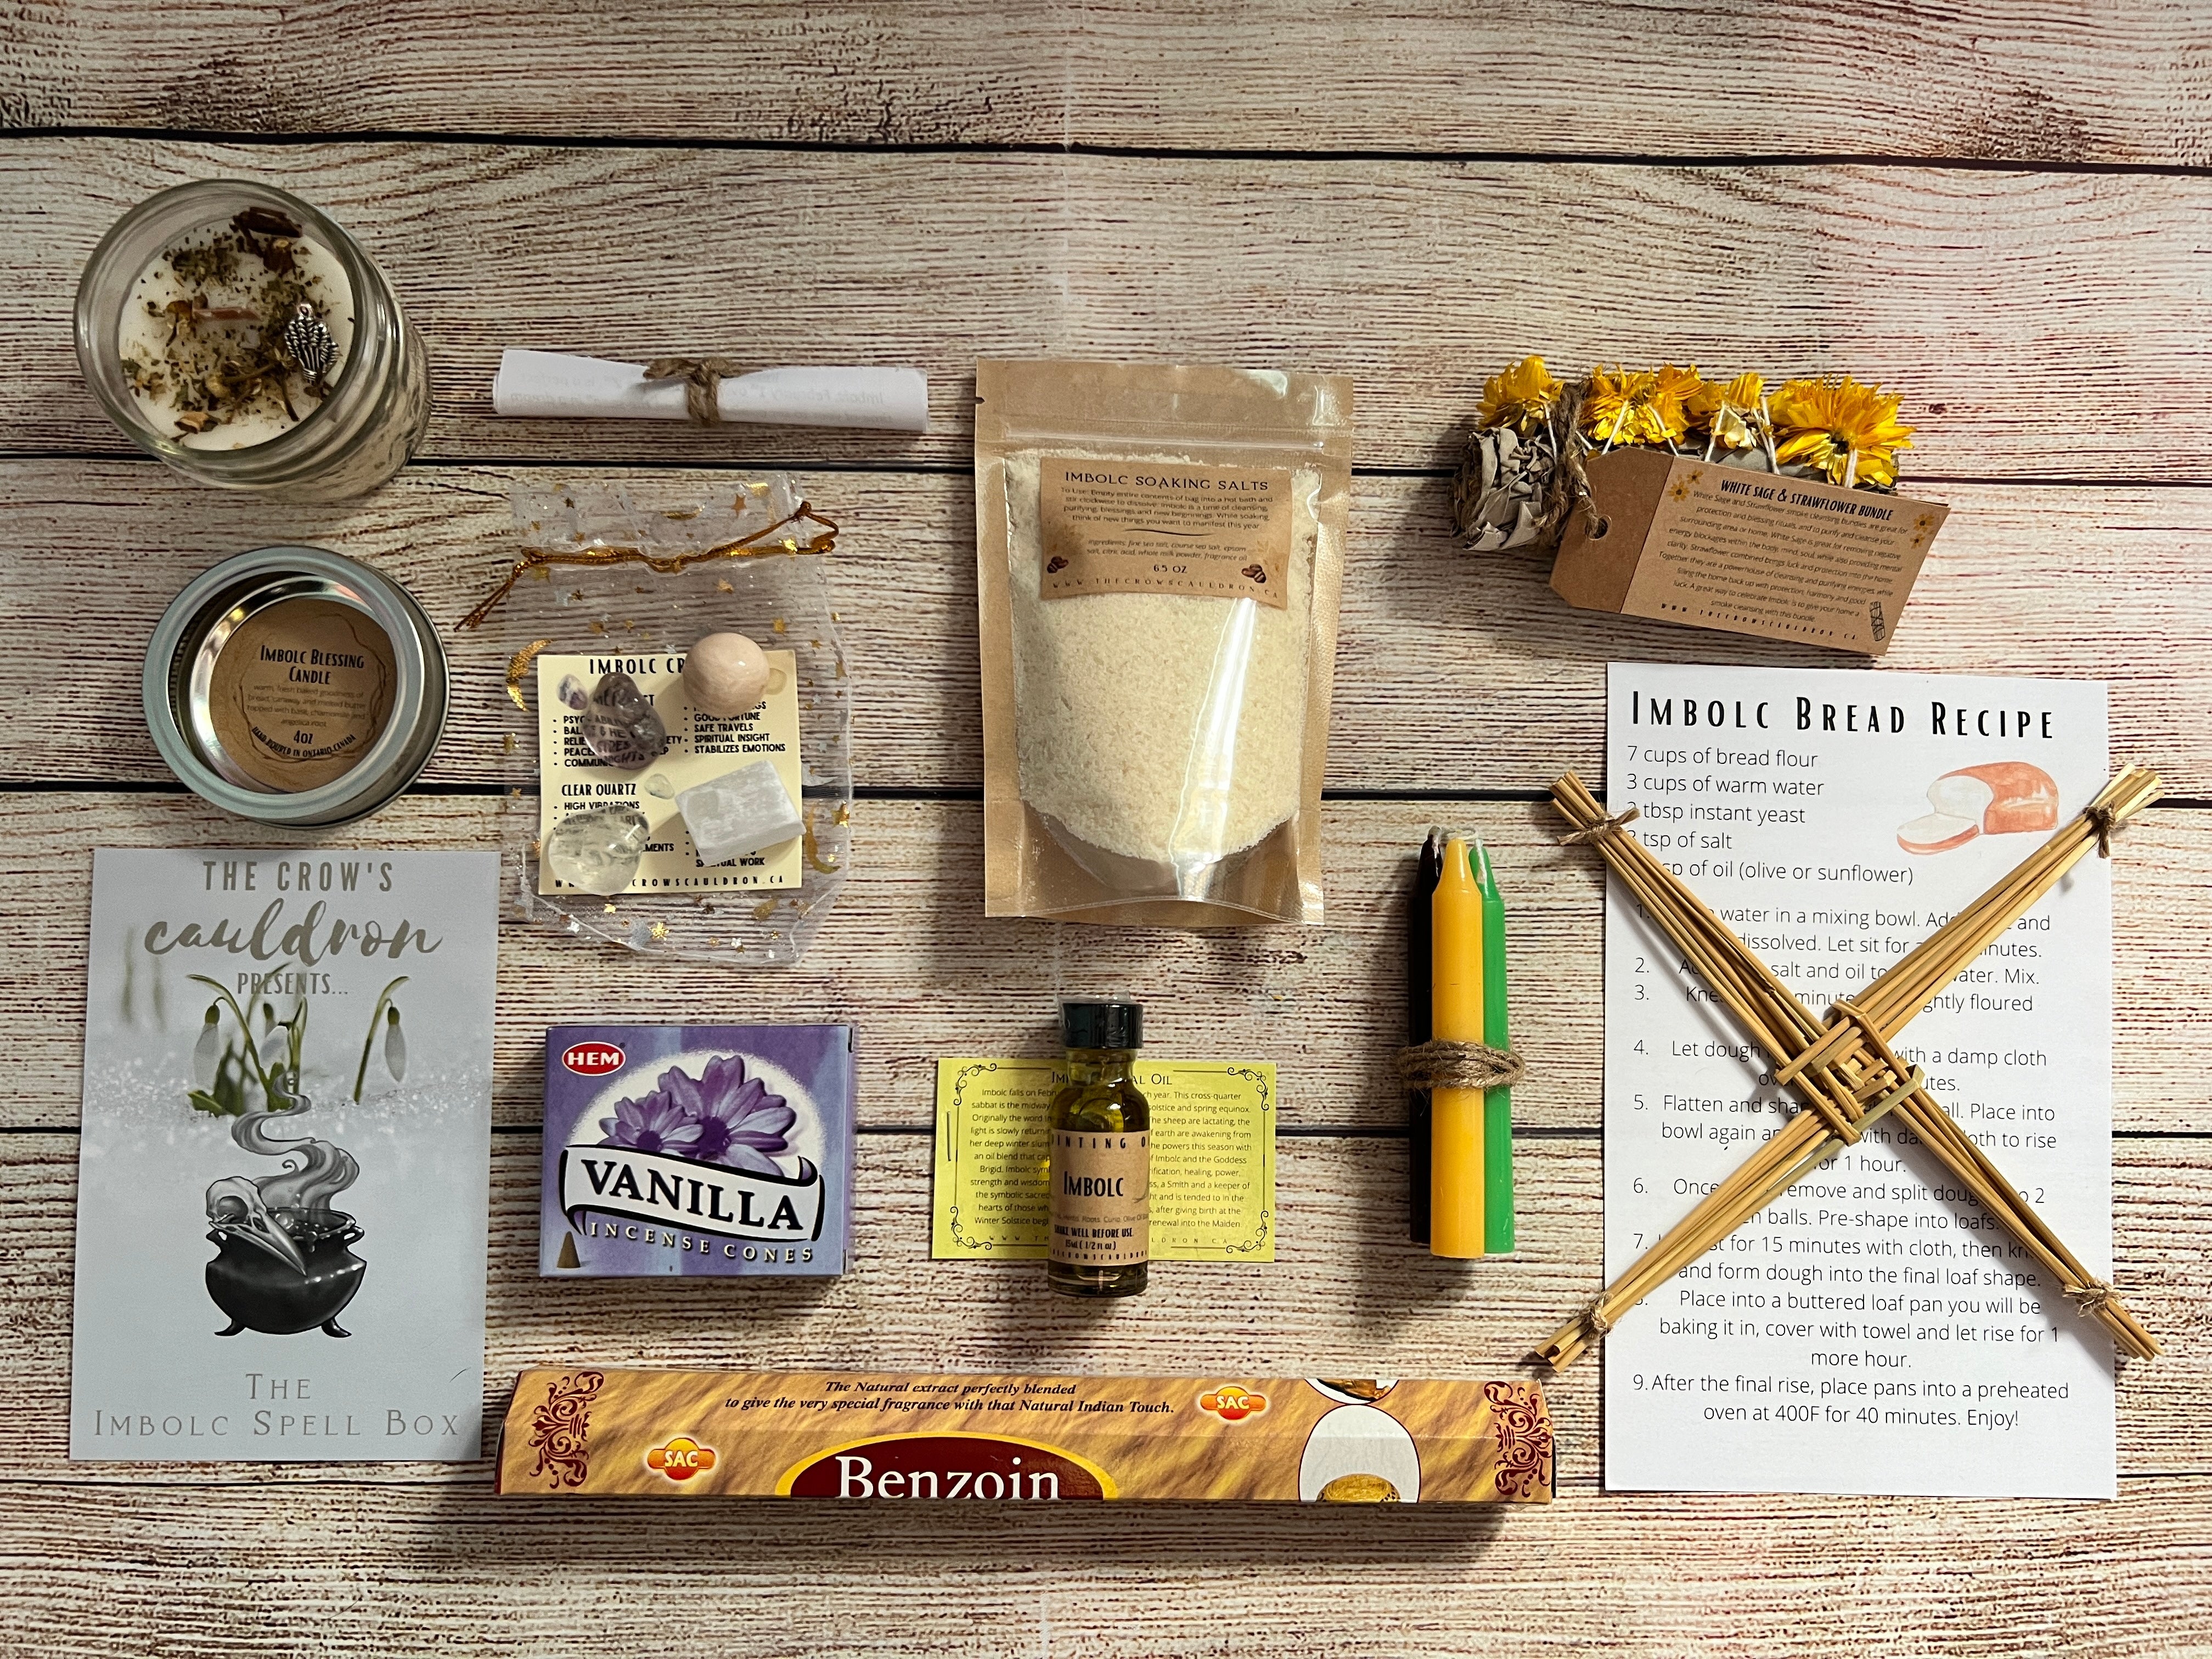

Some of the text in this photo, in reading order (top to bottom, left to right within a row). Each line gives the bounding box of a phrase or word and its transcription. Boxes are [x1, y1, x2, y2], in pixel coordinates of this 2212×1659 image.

[1065, 471, 1269, 492] IMBOLC SOAKING SALTS
[1721, 479, 1893, 520] WHITE SAGE & STRAWFLOWER BUNDLE
[1710, 600, 1732, 608] smoke
[1732, 604, 1764, 615] cleansing
[1764, 608, 1778, 616] with
[590, 659, 657, 674] IMBOLC
[717, 723, 753, 732] TRAVELS
[695, 733, 769, 743] SPIRITUAL INSIGHT
[695, 744, 785, 753] STABILIZES EMOTIONS
[1627, 745, 1818, 767] 7 cups of bread flour
[562, 784, 636, 796] CLEAR QUARTZ
[1626, 773, 1824, 795] 3 cups of warm water
[1643, 801, 1683, 823] tbsp
[1690, 803, 1752, 821] instant
[1757, 809, 1805, 826] yeast
[1643, 831, 1732, 851] tsp of salt
[203, 861, 393, 892] THE CROW'S
[1689, 859, 1912, 885] of oil (olive or sunflower)
[144, 898, 443, 966] cauldron
[237, 972, 348, 994] PRESENTS...
[567, 1053, 620, 1066] HEM
[1009, 1088, 1024, 1096] falls
[1177, 1103, 1191, 1111] and
[1194, 1105, 1217, 1114] spring
[581, 1159, 803, 1230] VANILLA
[590, 1223, 813, 1262] INCENSE CONES
[825, 1381, 1076, 1397] The Natural extract perfectly blended
[1633, 1373, 2068, 1402] 9. After the final rise, place pans into a preheated
[725, 1396, 1173, 1413] to give the very special fragrance with that Natural Indian Touch.
[1215, 1395, 1251, 1410] SAC
[1704, 1405, 2018, 1430] oven at 400F for 40 minutes. Enjoy!
[663, 1450, 699, 1467] SAC
[835, 1455, 1061, 1499] Benzoin
